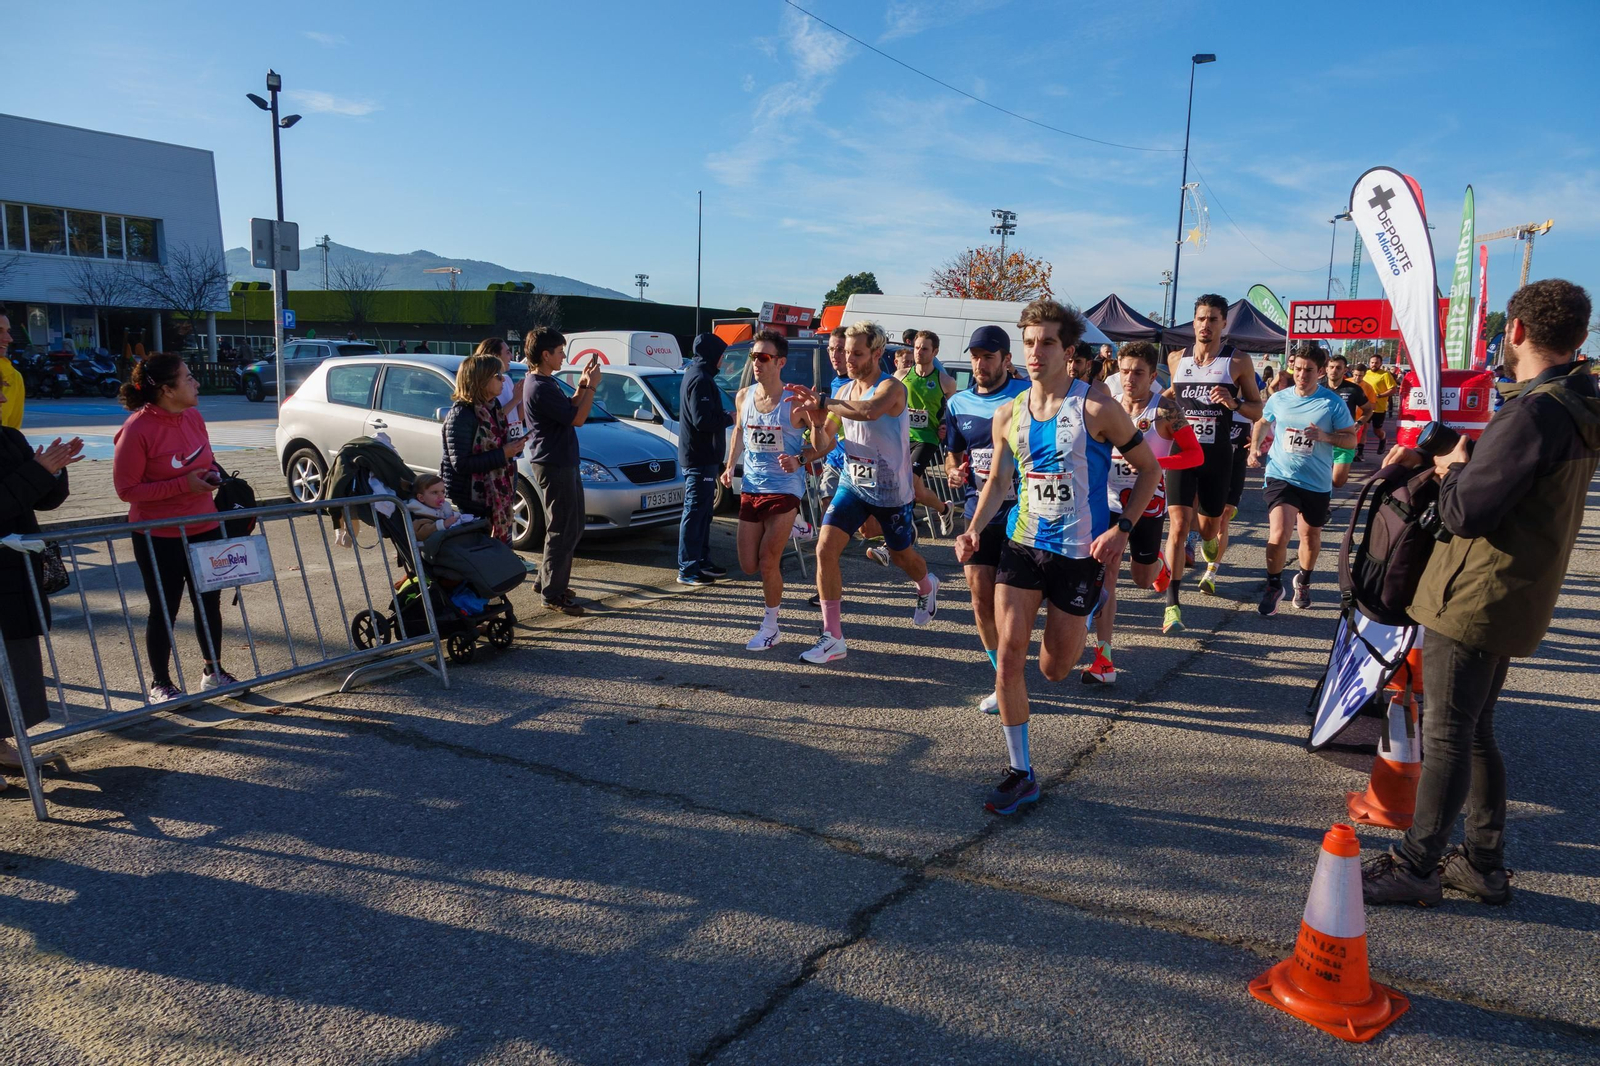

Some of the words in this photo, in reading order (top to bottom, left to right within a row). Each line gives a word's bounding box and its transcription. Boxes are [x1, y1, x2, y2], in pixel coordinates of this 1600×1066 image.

[1377, 211, 1413, 272] DEPORTE
[1375, 231, 1400, 276] Atlántico
[1295, 305, 1335, 319] RUN
[285, 313, 293, 326] P
[1181, 385, 1215, 399] delik
[909, 414, 927, 423] 139
[752, 431, 776, 444] 122
[1289, 435, 1313, 448] 144
[853, 464, 872, 479] 121
[647, 493, 666, 507] 7935
[668, 490, 682, 503] BXN
[1034, 484, 1071, 501] 143
[209, 552, 248, 570] TeamRelay
